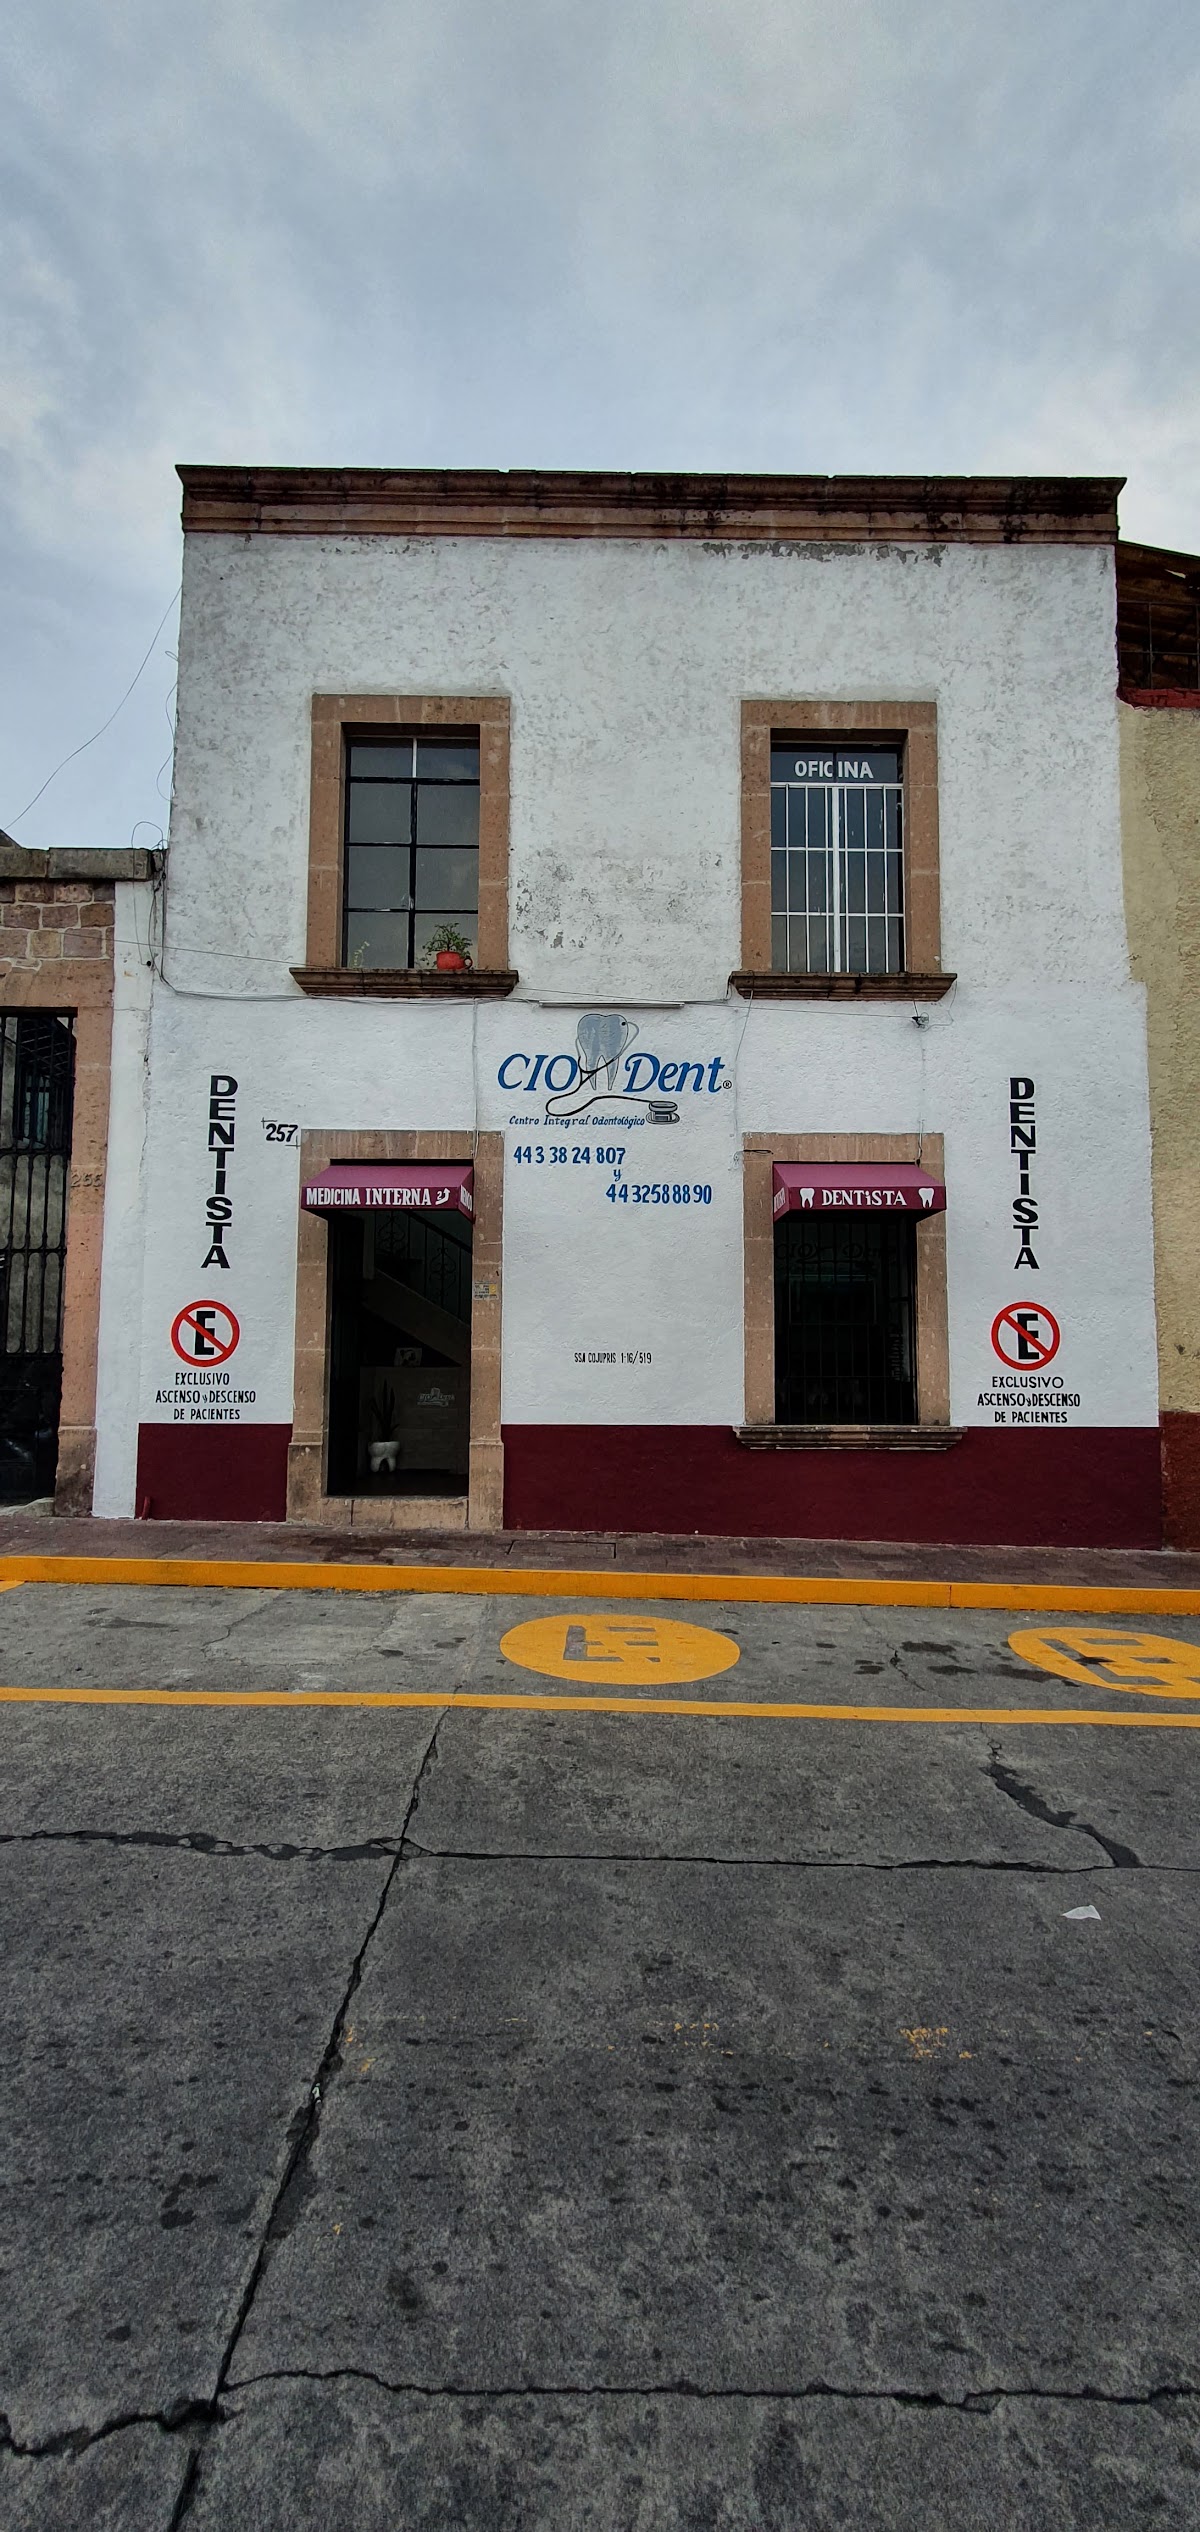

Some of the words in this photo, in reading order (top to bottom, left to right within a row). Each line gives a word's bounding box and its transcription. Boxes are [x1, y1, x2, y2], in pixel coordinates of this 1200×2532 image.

[795, 760, 874, 779] OFICINA
[497, 1053, 578, 1092] CIO
[509, 1115, 540, 1126] Centro
[543, 1114, 591, 1129] Integral
[592, 1115, 646, 1130] Odontológico
[265, 1122, 298, 1143] 257
[571, 1146, 591, 1165] 24
[596, 1147, 626, 1165] 807
[200, 1074, 239, 1269] DENTISTA
[613, 1169, 622, 1182] y
[1009, 1077, 1040, 1270] DENTISTA
[306, 1187, 361, 1206] MEDICINA
[365, 1188, 432, 1206] INTERNA
[194, 1310, 216, 1356] E
[1017, 1313, 1040, 1360] E
[175, 1372, 230, 1386] EXCLUSIVO
[992, 1376, 1064, 1389] EXCLUSIVO
[155, 1390, 201, 1404] ASCENSO
[209, 1390, 256, 1403] DESCENSO
[977, 1393, 1026, 1407] ASCENSO
[1032, 1393, 1080, 1407] DESCENSO
[174, 1408, 185, 1420] DE
[190, 1408, 241, 1420] PACIENTES
[994, 1411, 1006, 1423] DE
[1011, 1411, 1068, 1423] PACIENTES
